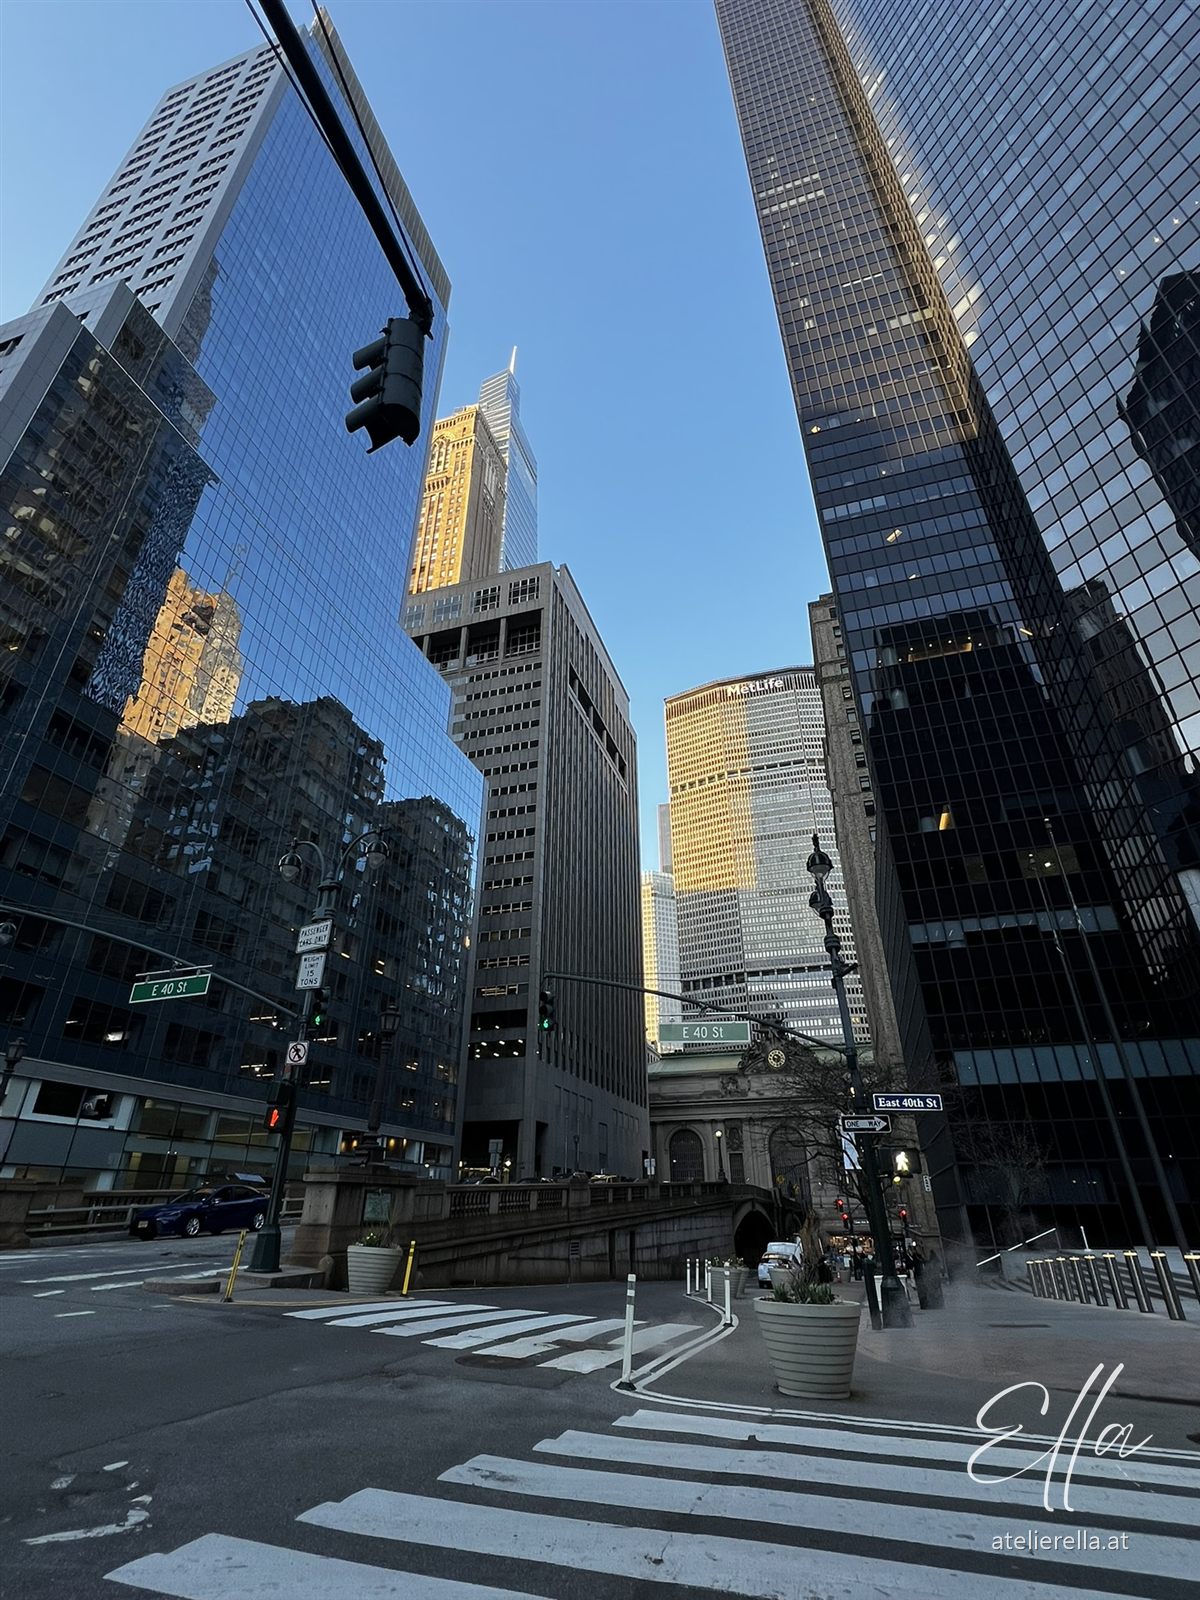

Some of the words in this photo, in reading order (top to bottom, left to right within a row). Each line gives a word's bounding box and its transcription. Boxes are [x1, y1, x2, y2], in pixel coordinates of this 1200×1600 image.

[727, 678, 784, 697] MetLife
[301, 977, 318, 985] TONS
[151, 984, 159, 996] E
[161, 982, 174, 995] 40
[176, 981, 188, 993] St
[682, 1026, 689, 1038] E
[693, 1026, 708, 1039] 40
[712, 1026, 724, 1038] St
[878, 1097, 900, 1107] East
[902, 1098, 925, 1108] 40th
[926, 1098, 938, 1108] St
[868, 1120, 881, 1128] WAY
